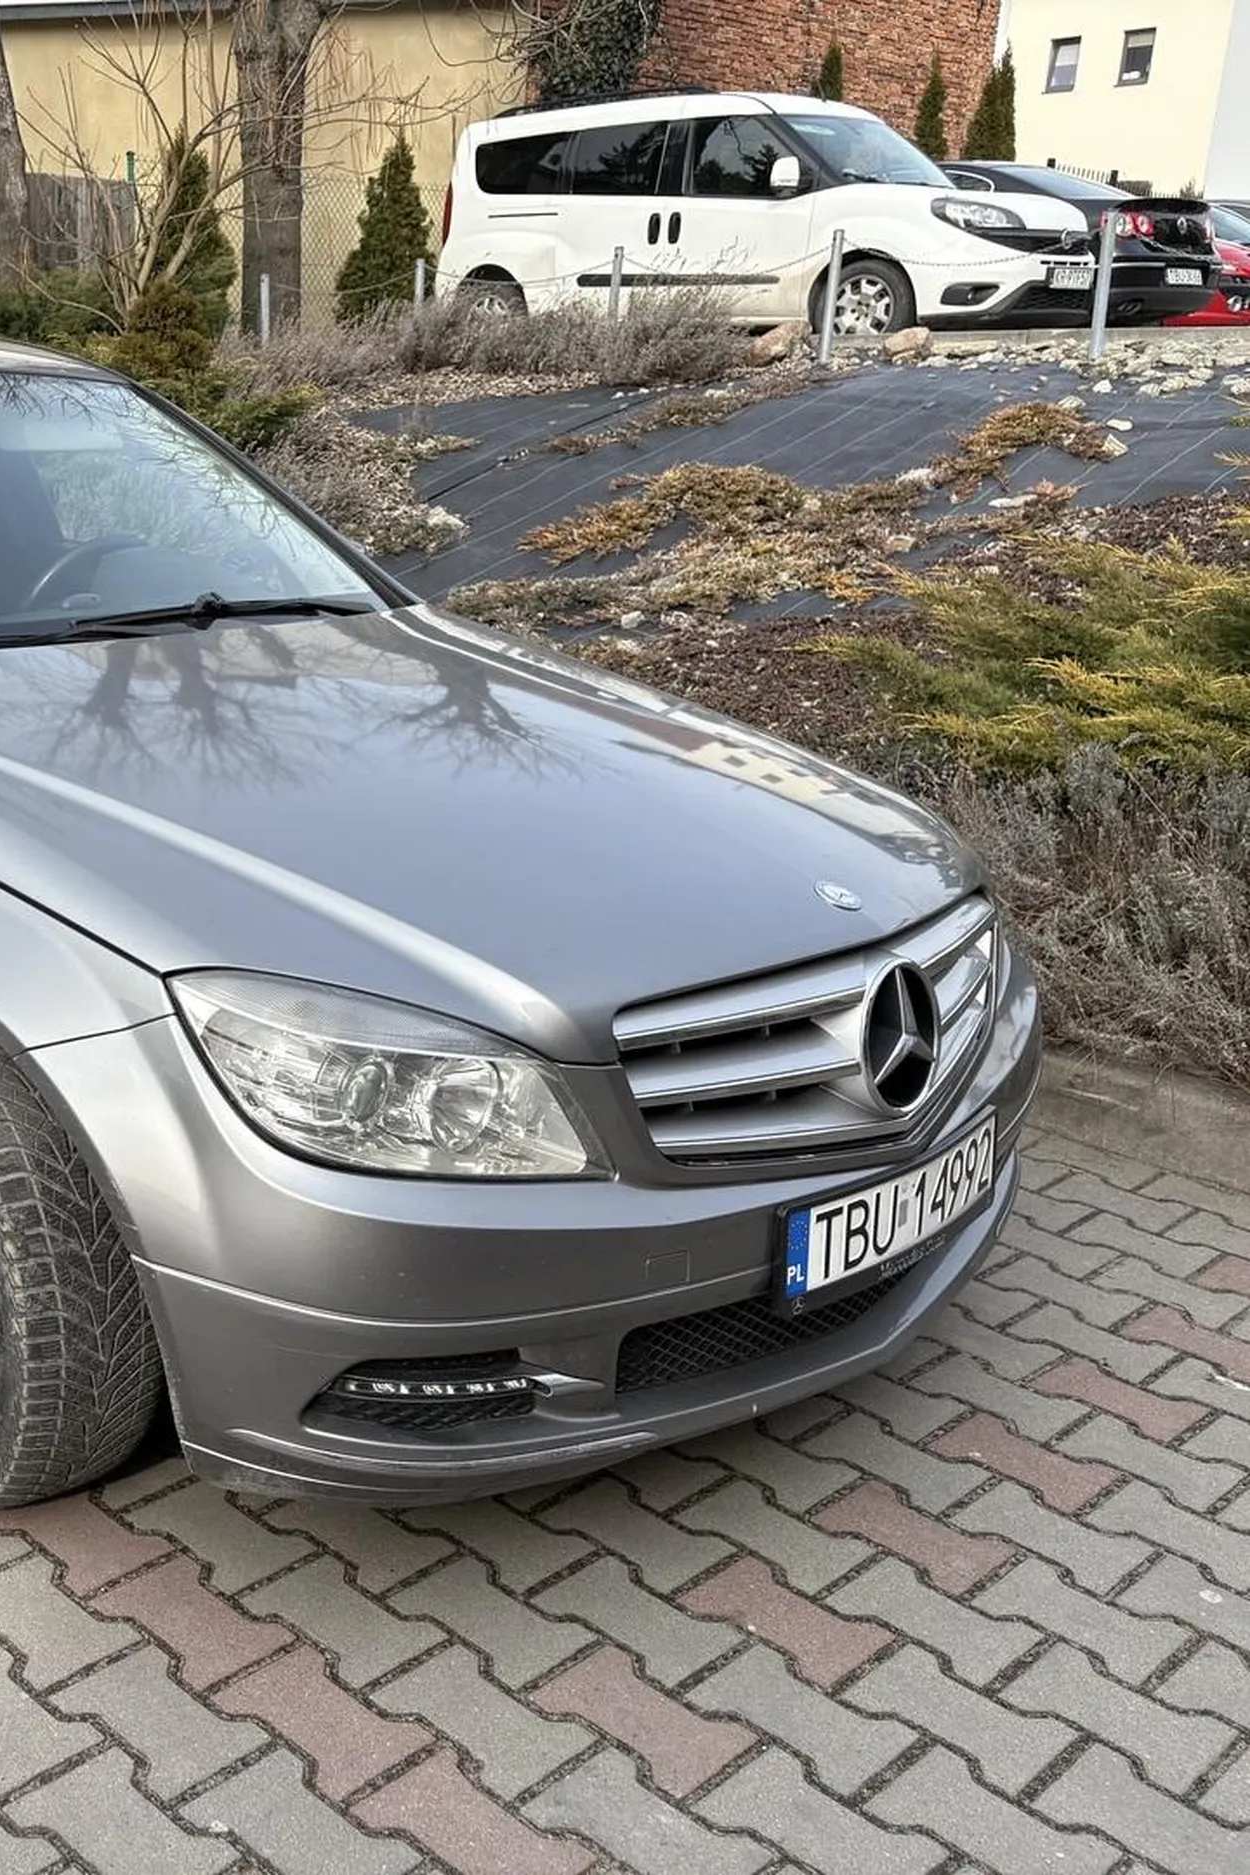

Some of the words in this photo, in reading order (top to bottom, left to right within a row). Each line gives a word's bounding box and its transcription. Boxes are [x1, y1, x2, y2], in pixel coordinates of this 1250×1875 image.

[814, 1184, 900, 1280] TBU
[913, 1126, 992, 1238] 14992
[786, 1265, 805, 1286] PL
